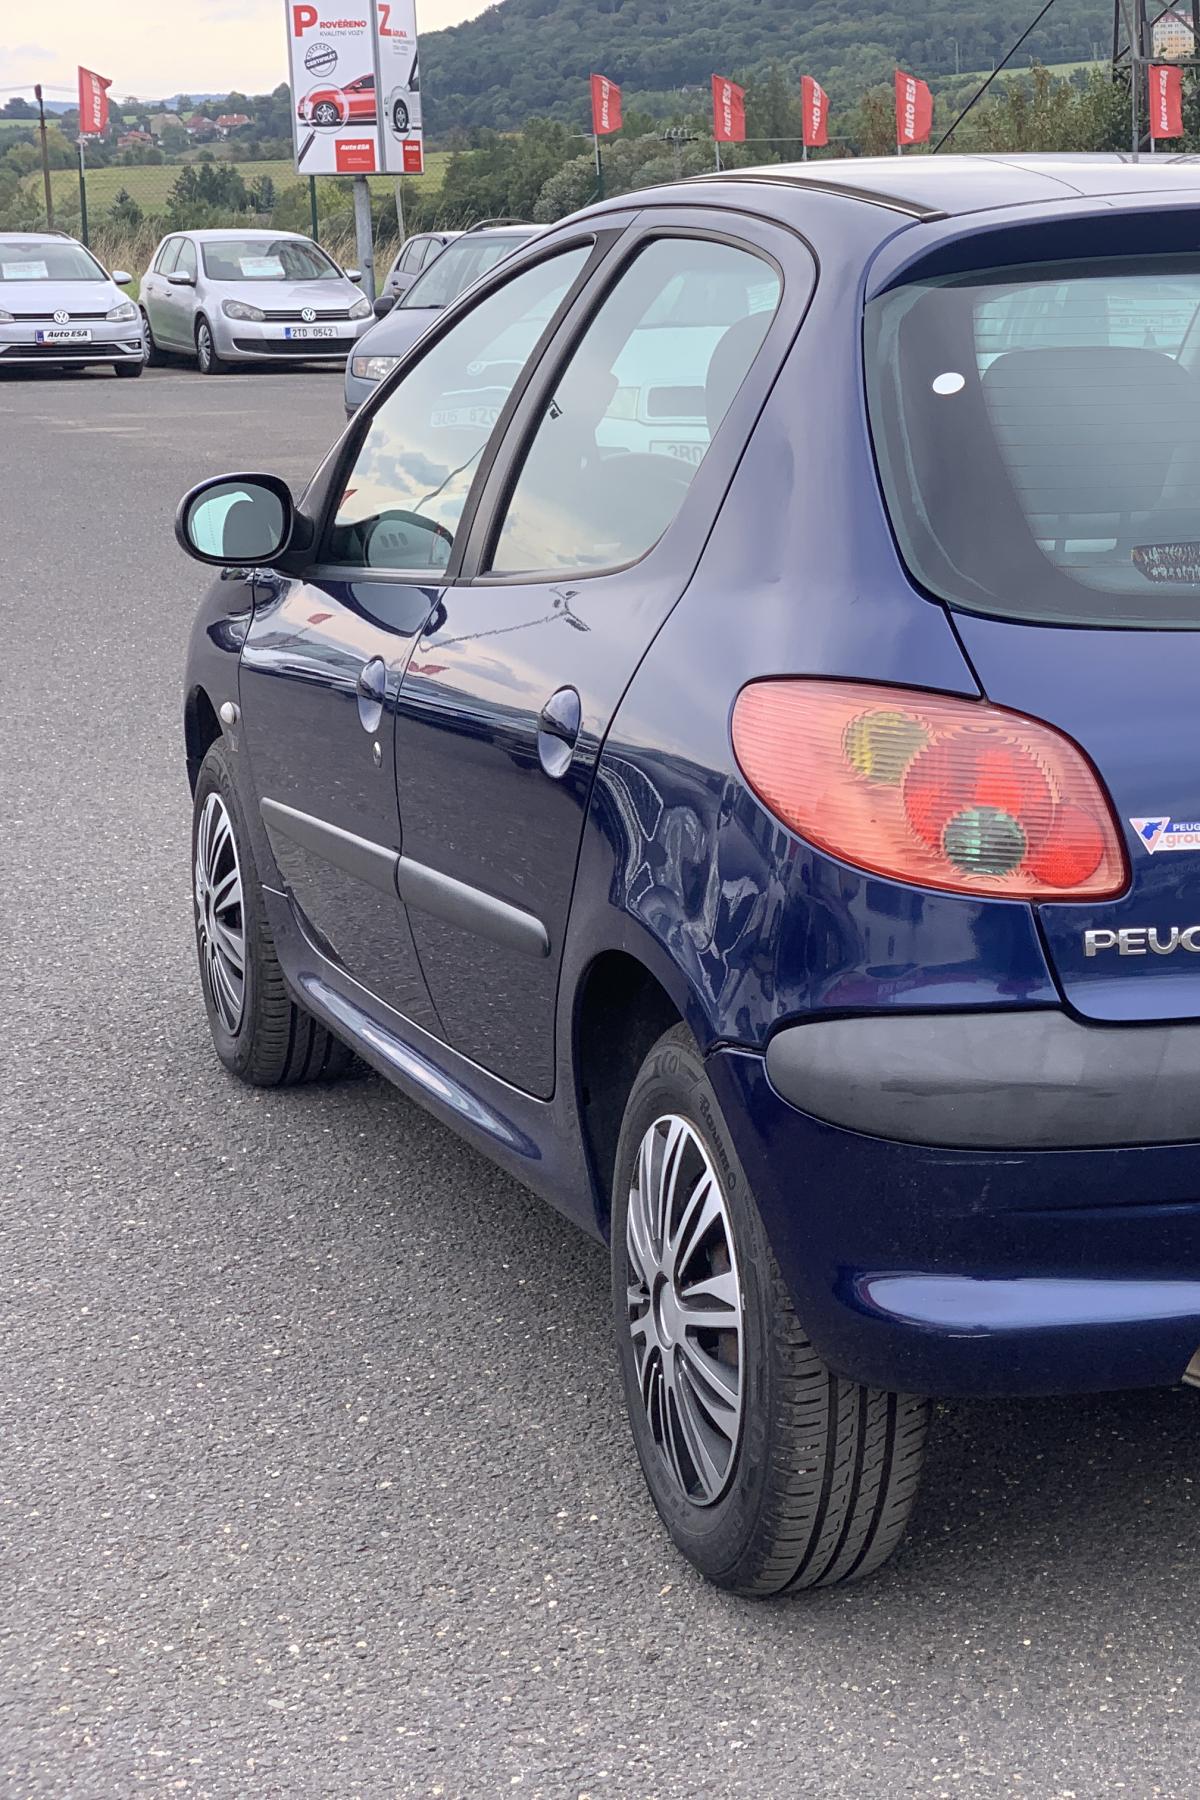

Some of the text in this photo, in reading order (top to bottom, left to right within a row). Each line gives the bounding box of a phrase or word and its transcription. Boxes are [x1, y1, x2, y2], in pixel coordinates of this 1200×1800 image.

[93, 96, 101, 127] Auto
[601, 101, 610, 129] Auto
[722, 104, 732, 136] Auto
[904, 103, 915, 139] Auto
[1160, 96, 1169, 131] Auto
[292, 328, 334, 338] 2TD 0542
